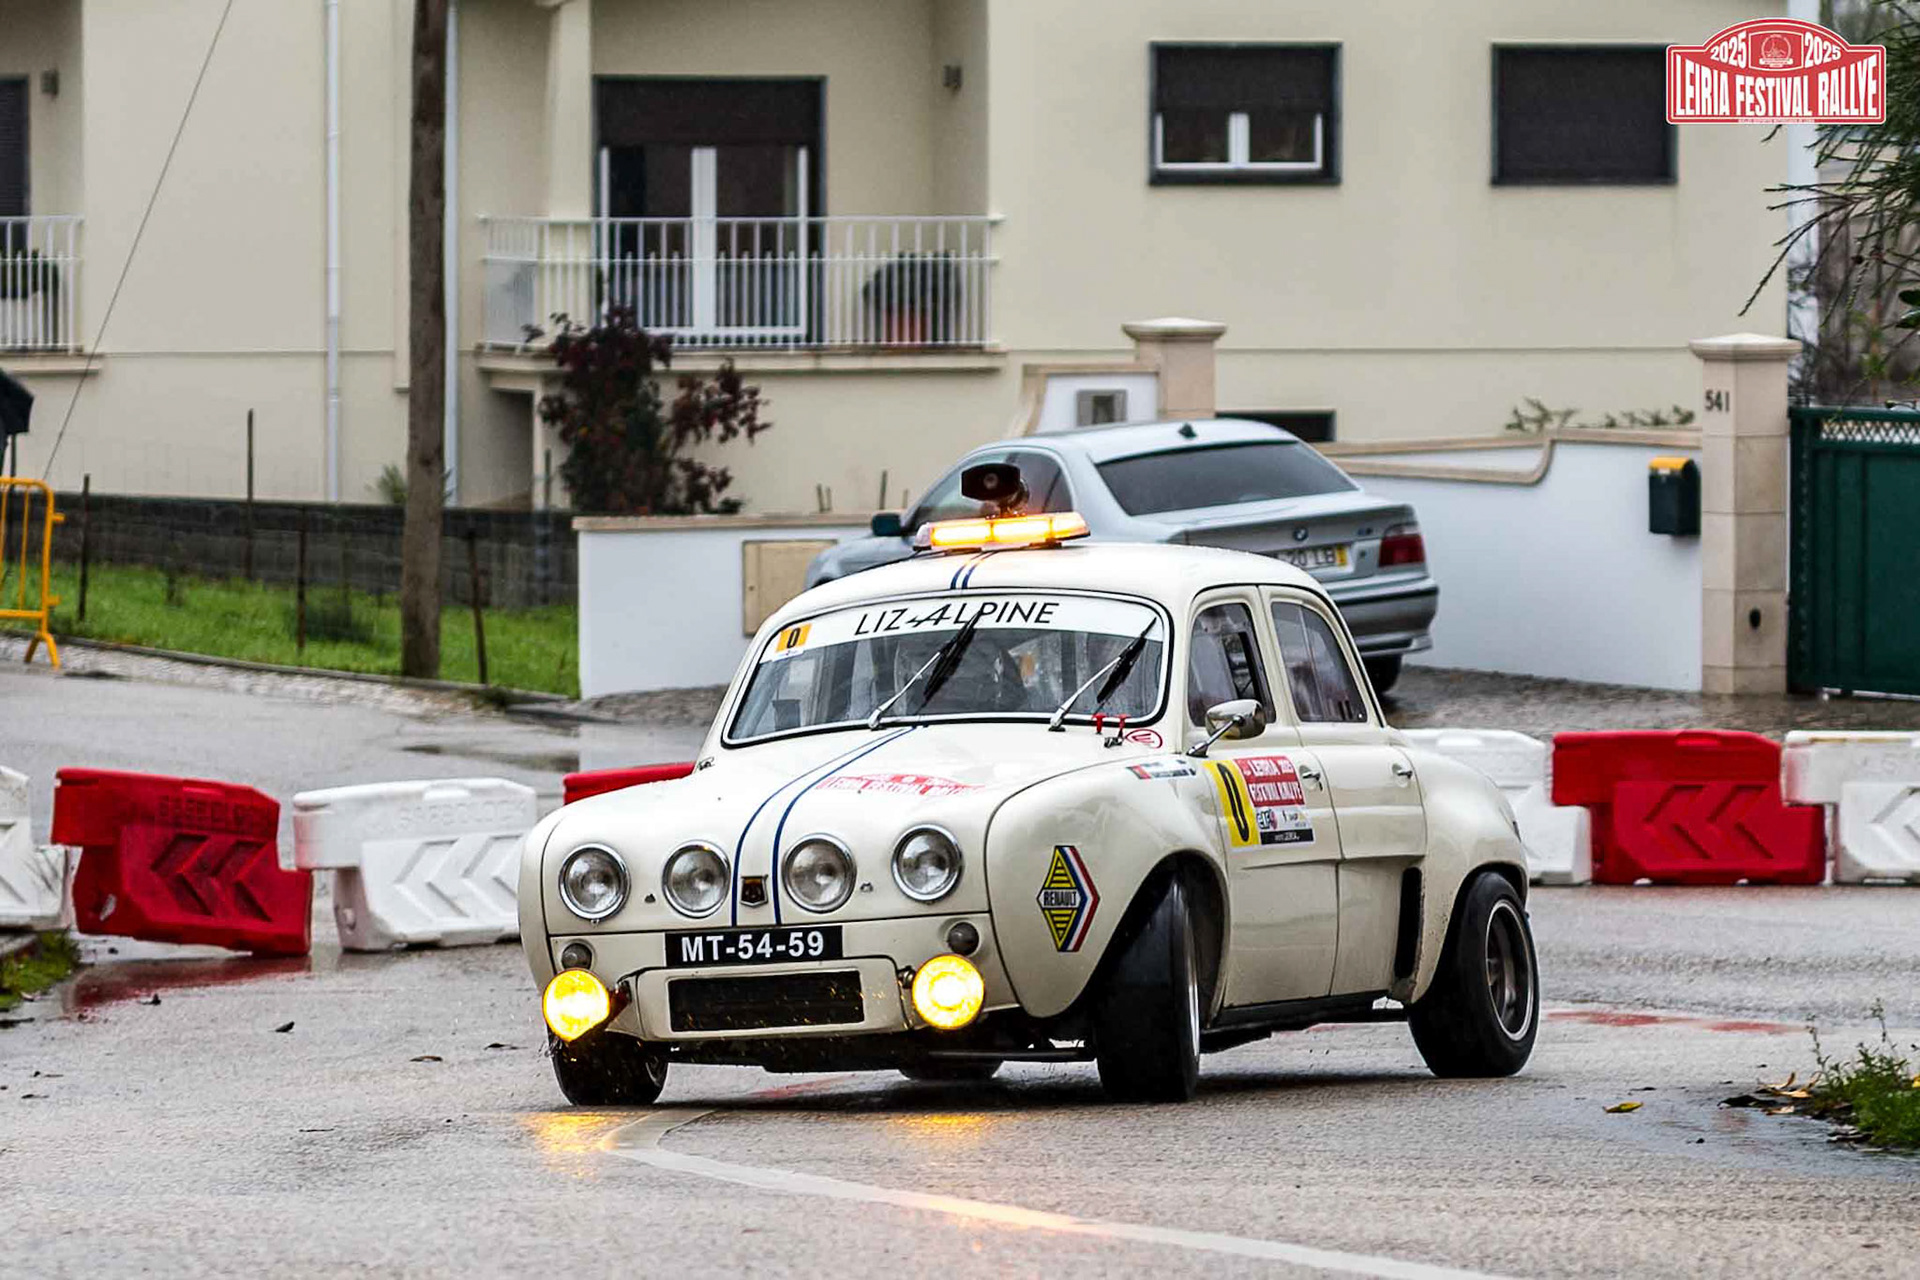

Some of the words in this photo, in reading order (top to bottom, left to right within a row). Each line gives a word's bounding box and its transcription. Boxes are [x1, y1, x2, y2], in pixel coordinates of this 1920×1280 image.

[1705, 389, 1730, 413] 541
[787, 628, 801, 649] 0
[1217, 763, 1250, 841] 0
[1043, 890, 1077, 907] RENAULT
[681, 931, 825, 962] MT-54-59
